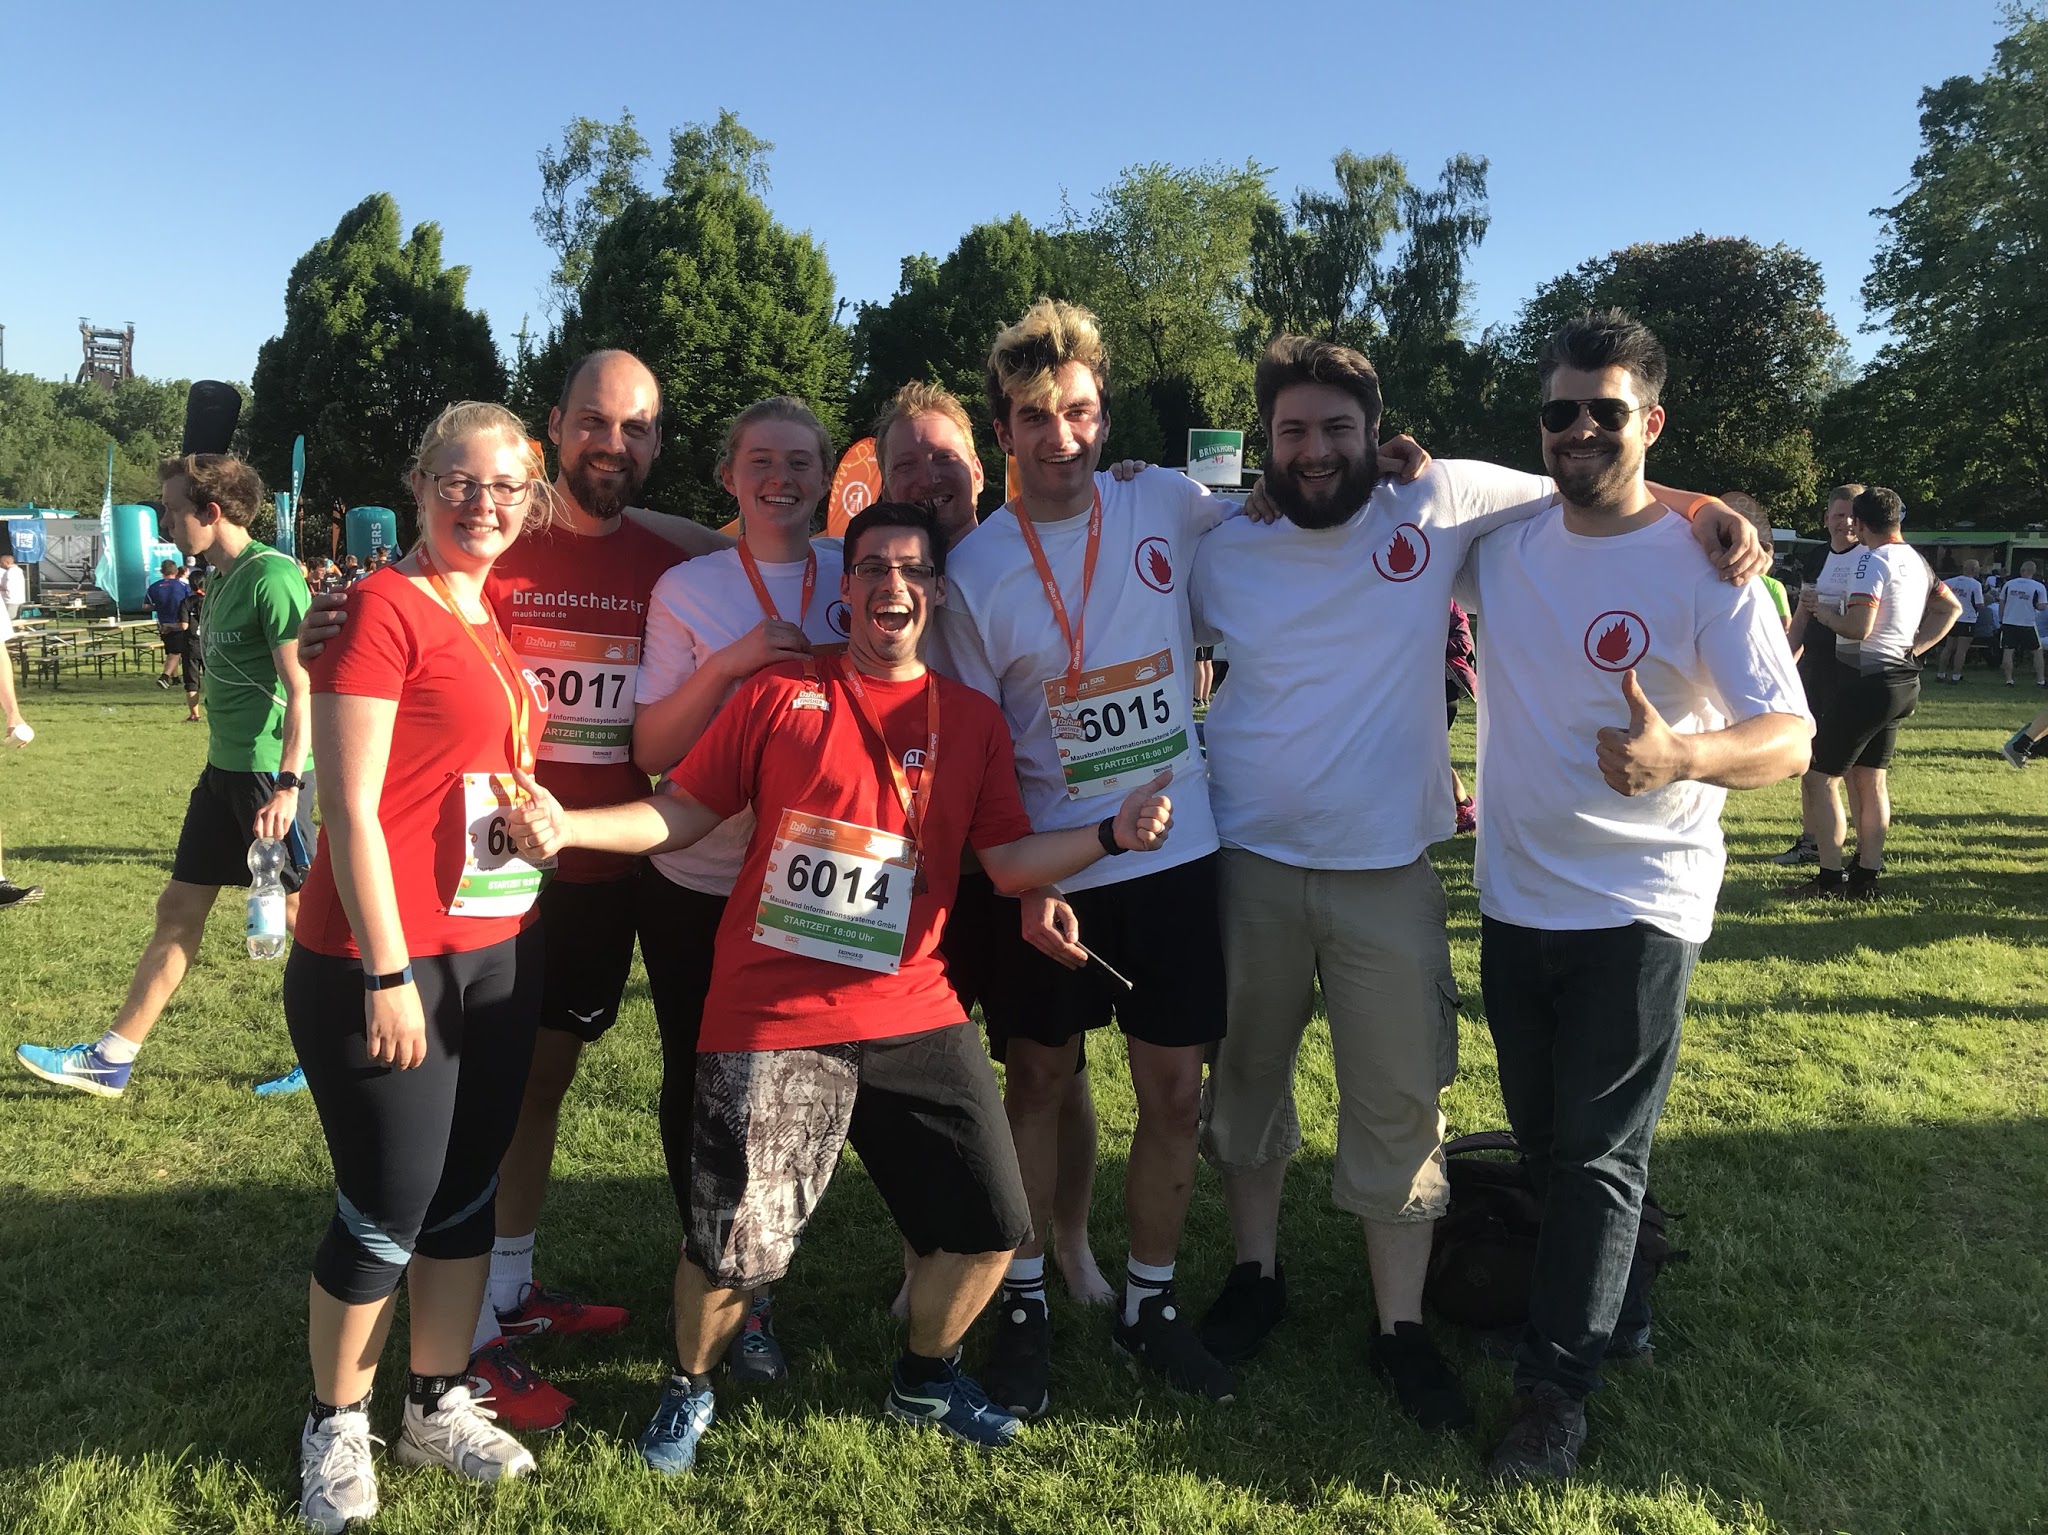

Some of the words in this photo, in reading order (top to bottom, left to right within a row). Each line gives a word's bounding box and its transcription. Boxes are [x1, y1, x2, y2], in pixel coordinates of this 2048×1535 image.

[512, 588, 644, 614] brandschatzer
[512, 609, 567, 619] mausbrand.de
[533, 667, 626, 709] 6017
[1059, 682, 1088, 696] Bun
[553, 713, 618, 724] Informationssysteme
[1077, 688, 1170, 743] 6015
[543, 727, 583, 738] ARTZEIT
[585, 731, 607, 740] 18:00
[607, 731, 618, 740] Uhr
[1070, 749, 1107, 762] Mausbrand
[1107, 732, 1170, 753] Informationssysteme
[1169, 725, 1181, 735] GmbH
[1093, 754, 1139, 772] STARTZEIT
[1140, 748, 1162, 761] 18:00
[1162, 744, 1174, 755] Uhr
[789, 820, 817, 836] B2Run
[787, 854, 890, 911] 6014
[769, 894, 802, 910] Mausbrand
[803, 903, 876, 926] Informationssysteme
[876, 919, 897, 930] GmbH
[783, 915, 831, 933] STARTZEIT
[833, 927, 857, 939] 18:00
[858, 932, 875, 943] Uhr
